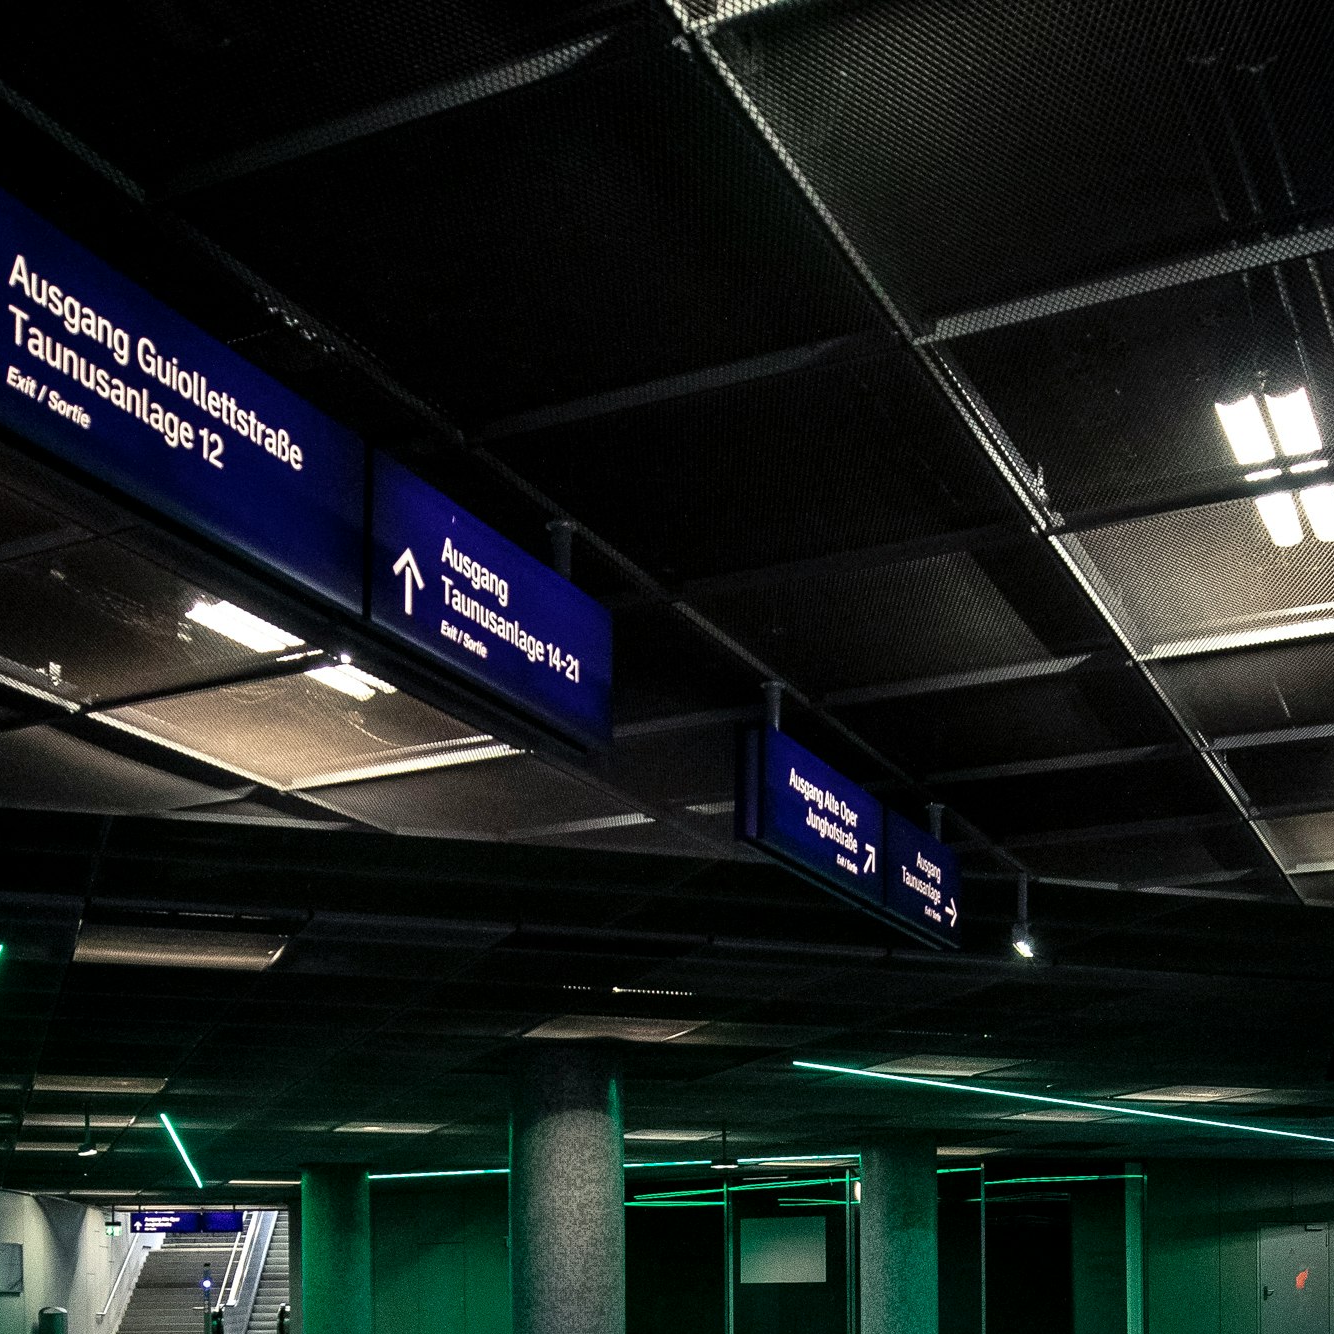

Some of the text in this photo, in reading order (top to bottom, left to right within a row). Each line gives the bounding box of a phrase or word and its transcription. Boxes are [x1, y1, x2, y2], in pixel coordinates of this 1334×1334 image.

[8, 254, 303, 471] Ausgang Guiollettstraße
[8, 304, 224, 469] Taunusanlage 12
[6, 365, 91, 429] Exit / Sortie
[441, 537, 509, 607] Ausgang
[440, 619, 458, 642] Exit
[463, 632, 488, 659] Sortie
[441, 574, 580, 683] Taunusanlage 14-21
[789, 767, 858, 828] Ausgang Alte Oper
[806, 806, 858, 854] Junghofstraße
[916, 851, 941, 884] Ausgang
